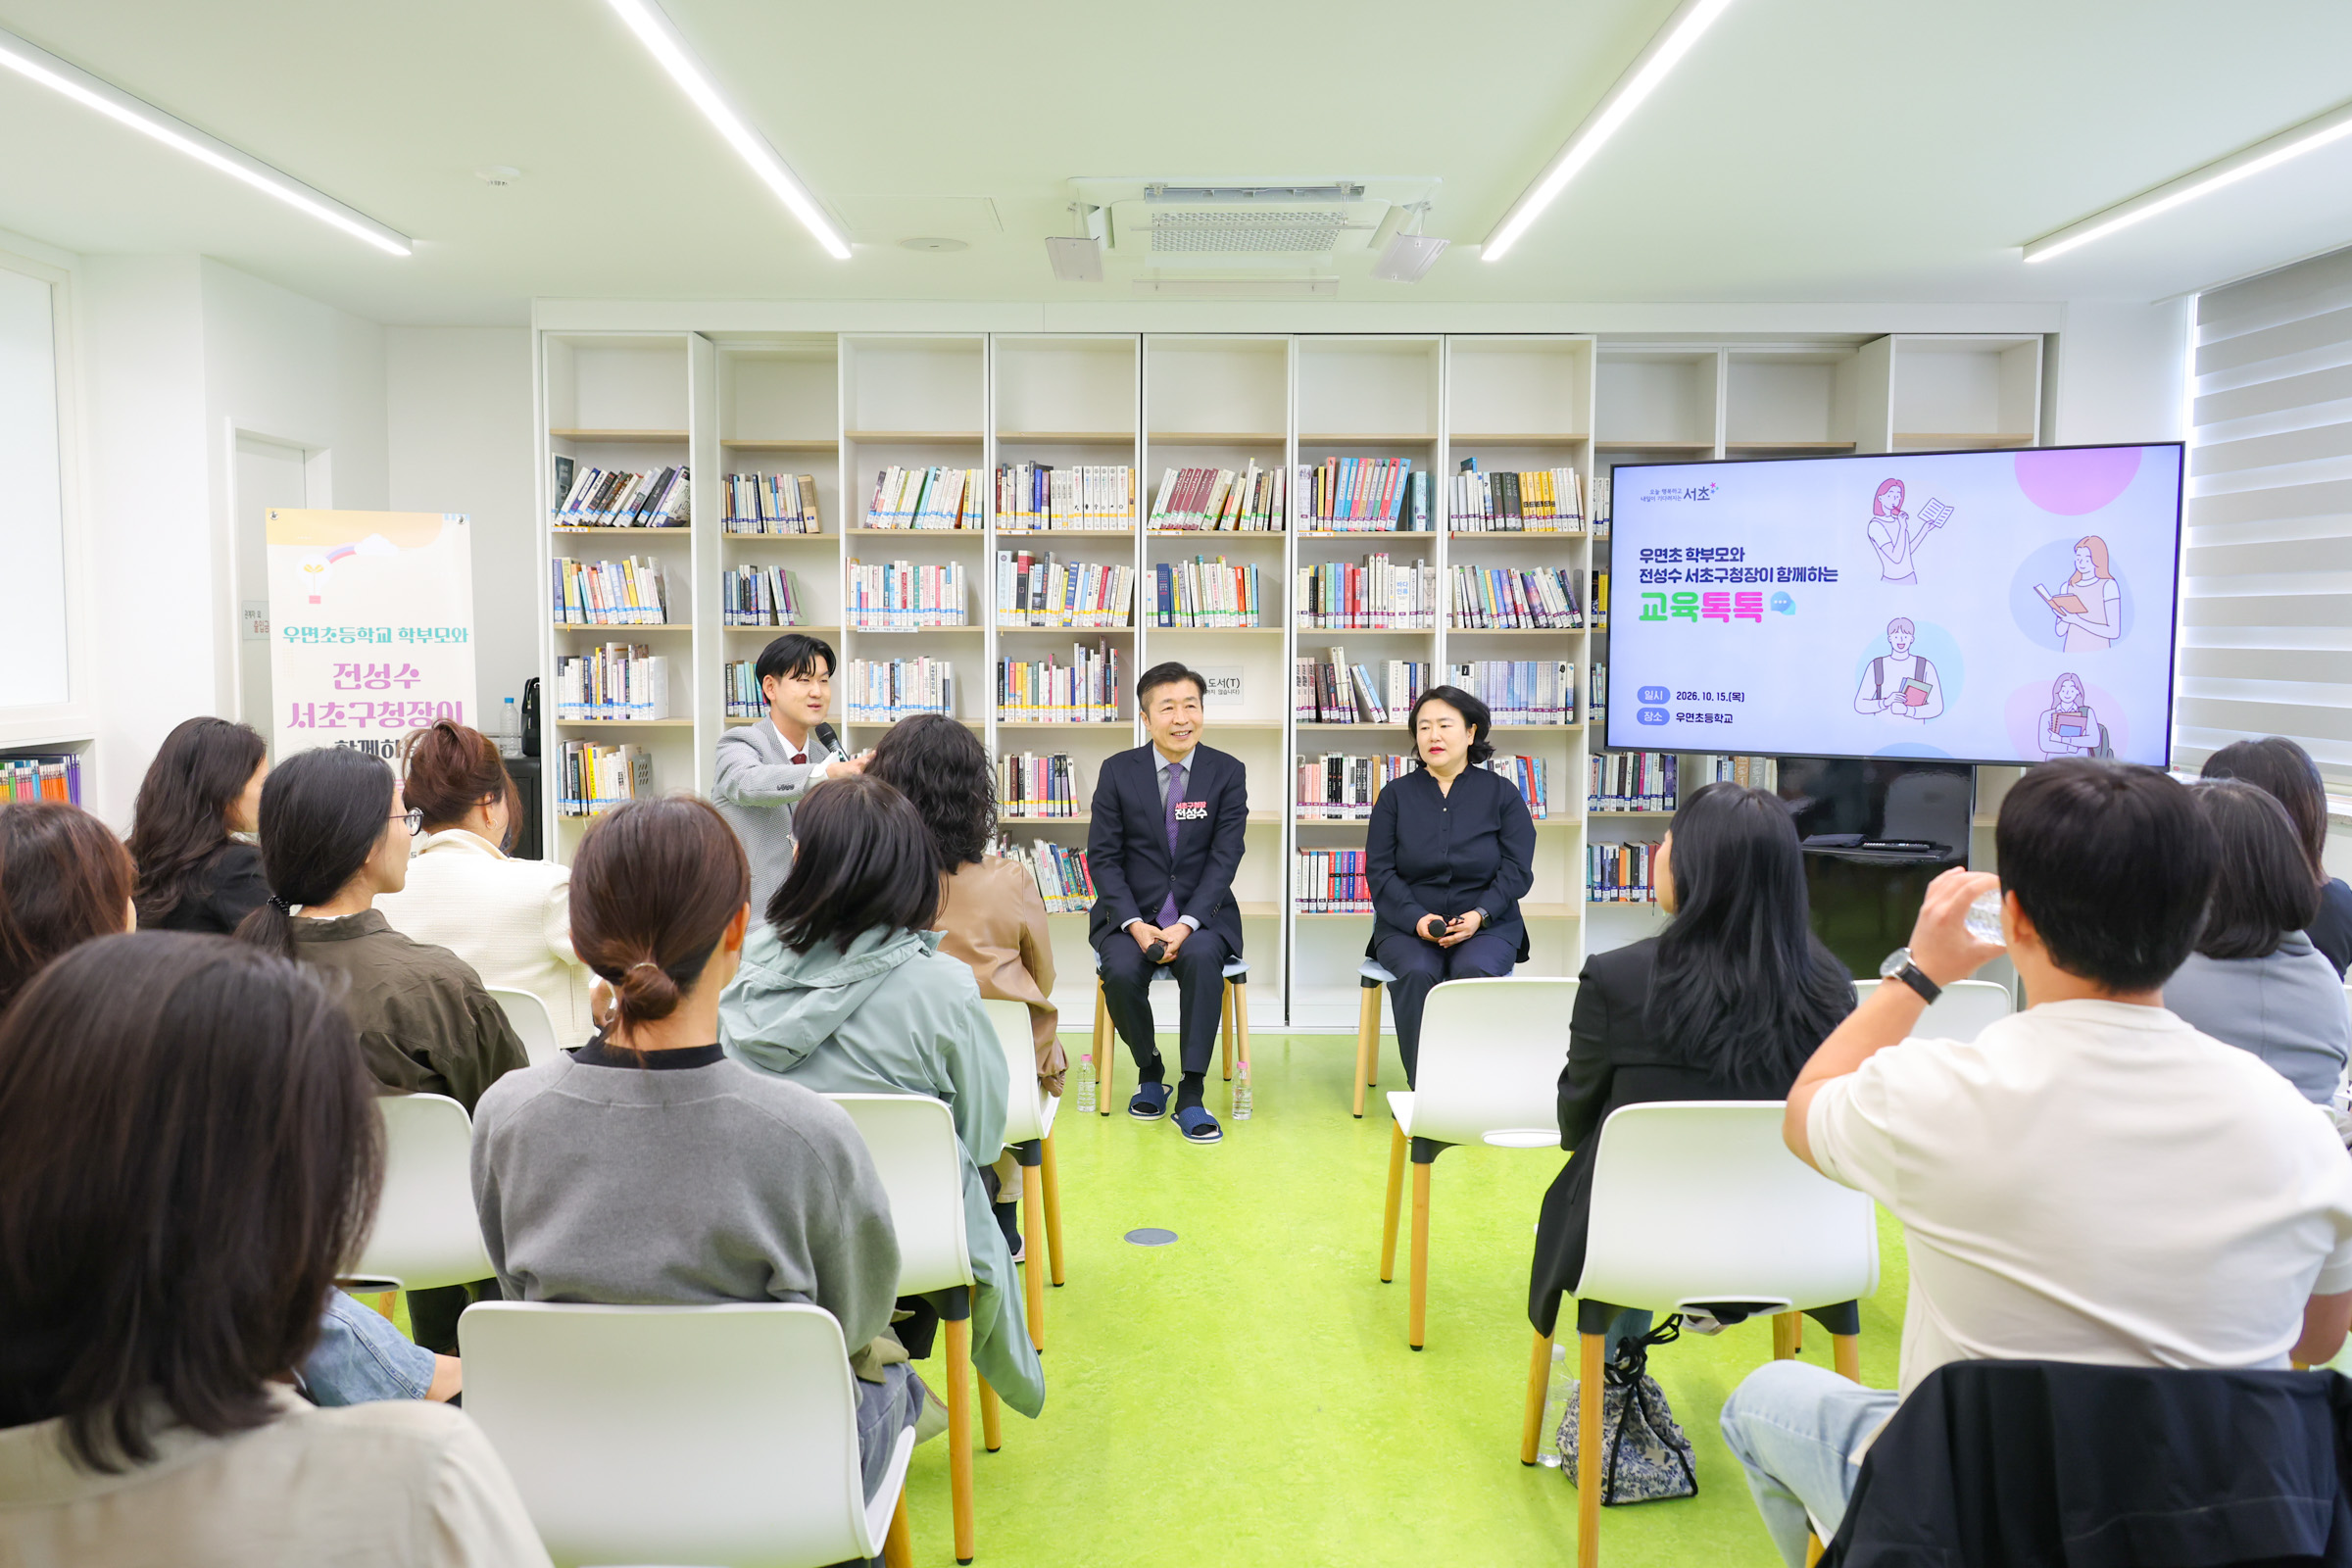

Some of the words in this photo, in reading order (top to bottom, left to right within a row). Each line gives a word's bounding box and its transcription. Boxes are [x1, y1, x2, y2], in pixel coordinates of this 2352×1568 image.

[1683, 486, 1710, 501] 서초
[1639, 547, 1683, 564] 우면초
[1685, 546, 1745, 564] 학부모와
[1639, 567, 1683, 584] 전성수
[1685, 566, 1774, 584] 서초구청장이
[1776, 565, 1838, 583] 함께하는
[1639, 591, 1764, 623] 교육톡톡
[282, 626, 393, 644] 우면초등학교
[397, 626, 469, 644] 학부모와
[332, 662, 421, 690] 전성수
[1207, 677, 1241, 689] 도서(T)
[1643, 690, 1663, 701] 일시
[1676, 691, 1700, 702] 2026.
[1702, 691, 1714, 702] 10.
[1716, 691, 1745, 703] 15.(목)
[286, 701, 464, 728] 서초구청장이
[1643, 711, 1663, 722] 장소
[1676, 712, 1734, 724] 우면초등학교
[1175, 808, 1208, 820] 전성수
